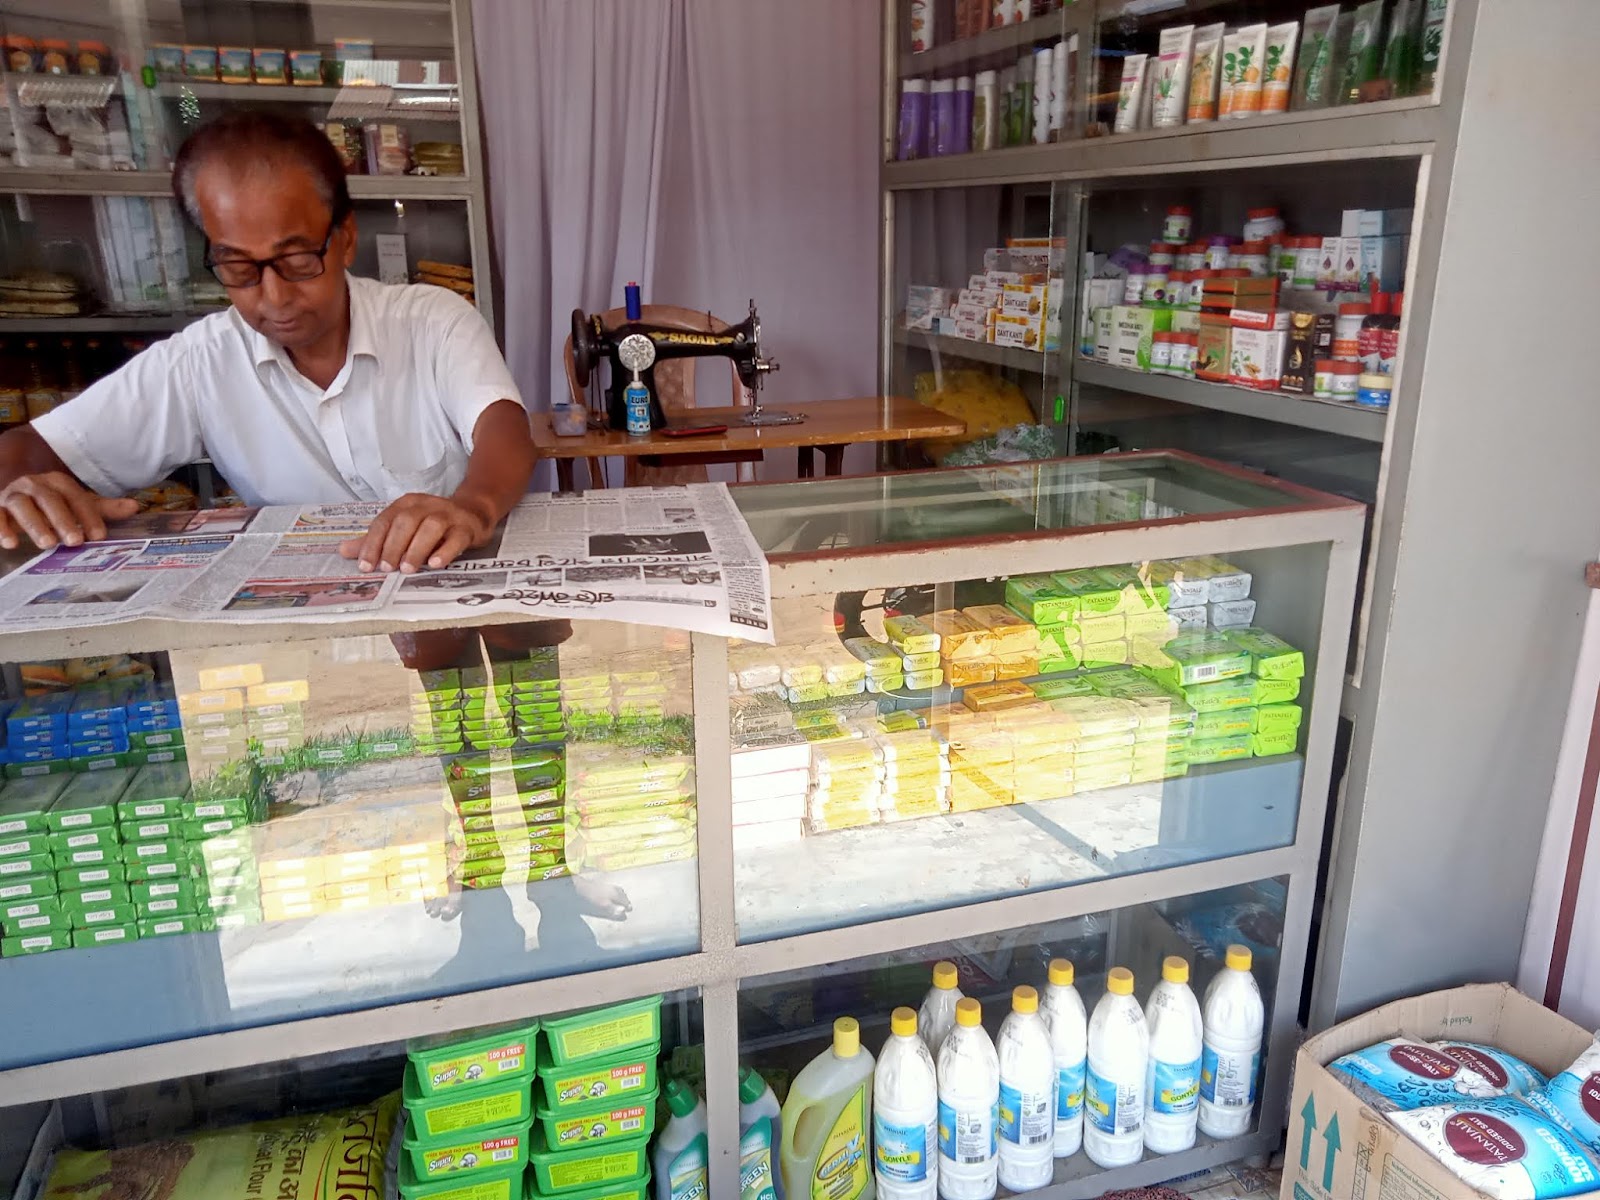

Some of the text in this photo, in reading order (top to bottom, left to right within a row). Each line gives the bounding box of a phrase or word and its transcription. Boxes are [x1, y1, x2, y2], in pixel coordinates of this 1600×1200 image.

[669, 332, 717, 346] SAGAR
[433, 1067, 460, 1087] Super
[560, 1084, 585, 1102] Super
[1456, 1120, 1508, 1161] PATANJALI
[1469, 1116, 1517, 1152] IODISED SALT
[428, 1155, 454, 1172] Super
[1535, 1127, 1585, 1184] IODISED
[246, 1162, 273, 1194] Flour
